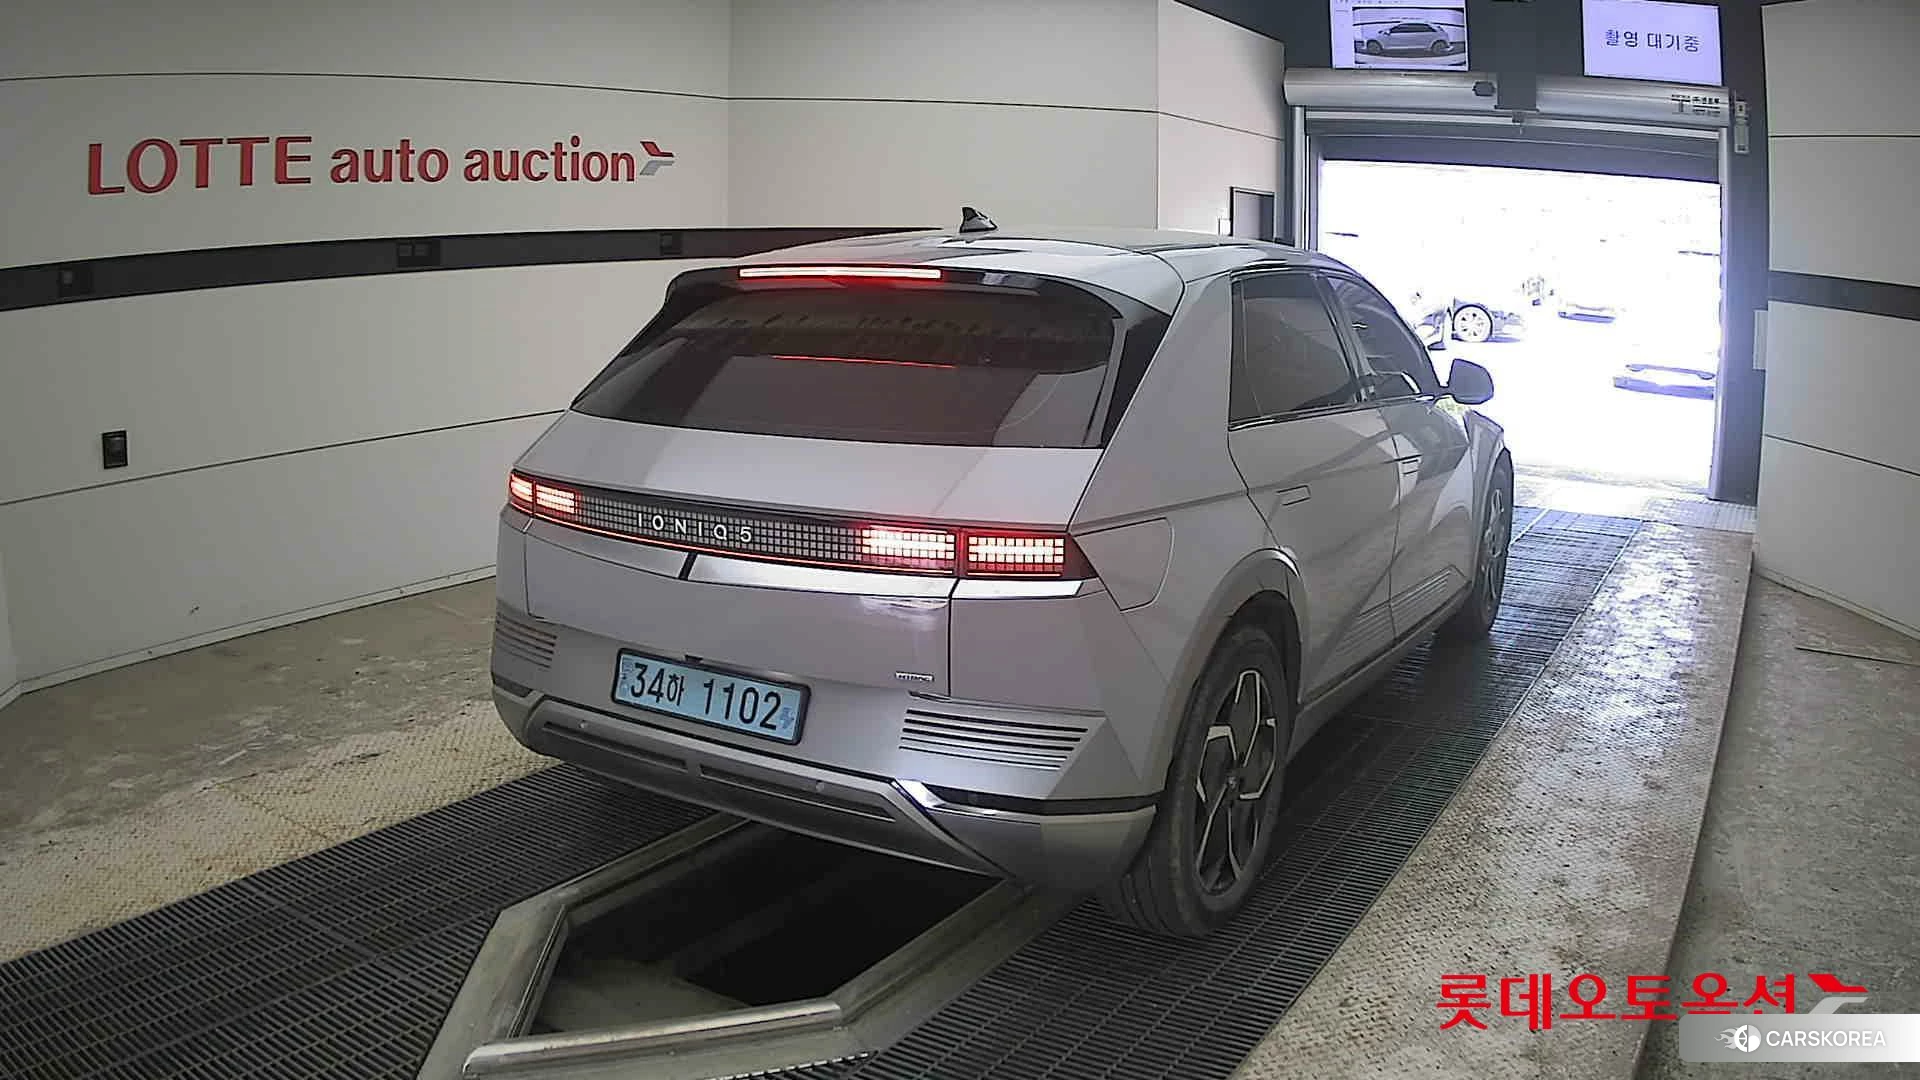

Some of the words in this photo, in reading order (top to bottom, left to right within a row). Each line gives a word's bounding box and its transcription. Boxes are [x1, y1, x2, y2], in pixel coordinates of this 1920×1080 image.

[1647, 32, 1700, 53] 대기중
[88, 136, 312, 195] LOTTE
[330, 139, 449, 183] auto
[463, 135, 636, 183] auction
[638, 512, 727, 541] IONIQ
[739, 526, 752, 543] 5
[630, 662, 684, 706] 34하
[703, 679, 782, 731] 1102
